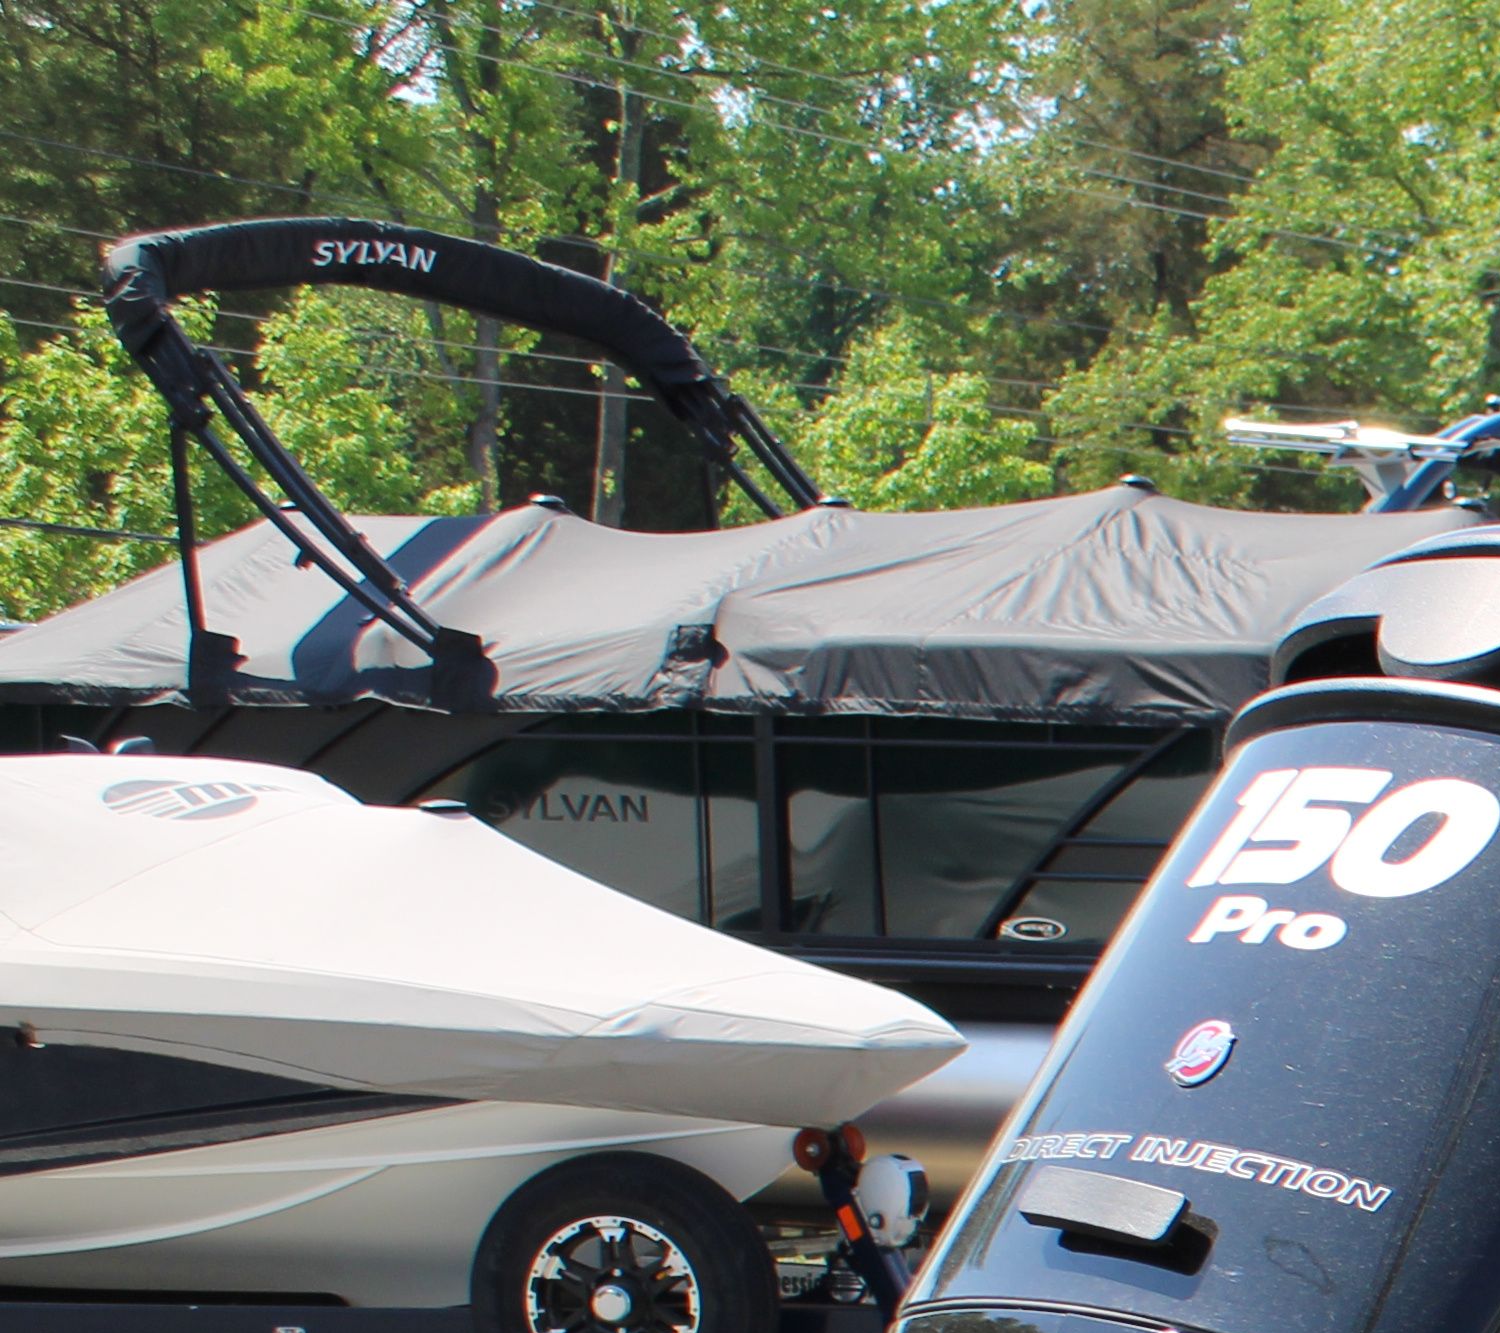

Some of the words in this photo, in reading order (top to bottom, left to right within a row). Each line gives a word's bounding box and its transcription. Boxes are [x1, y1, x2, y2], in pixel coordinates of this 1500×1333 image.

[312, 240, 437, 273] SYLVAN
[486, 792, 649, 823] SYLVAN
[1186, 765, 1500, 898] 150
[1187, 893, 1348, 950] Pro
[1001, 1133, 1133, 1163] DIRECT
[1131, 1136, 1392, 1213] INJECTION
